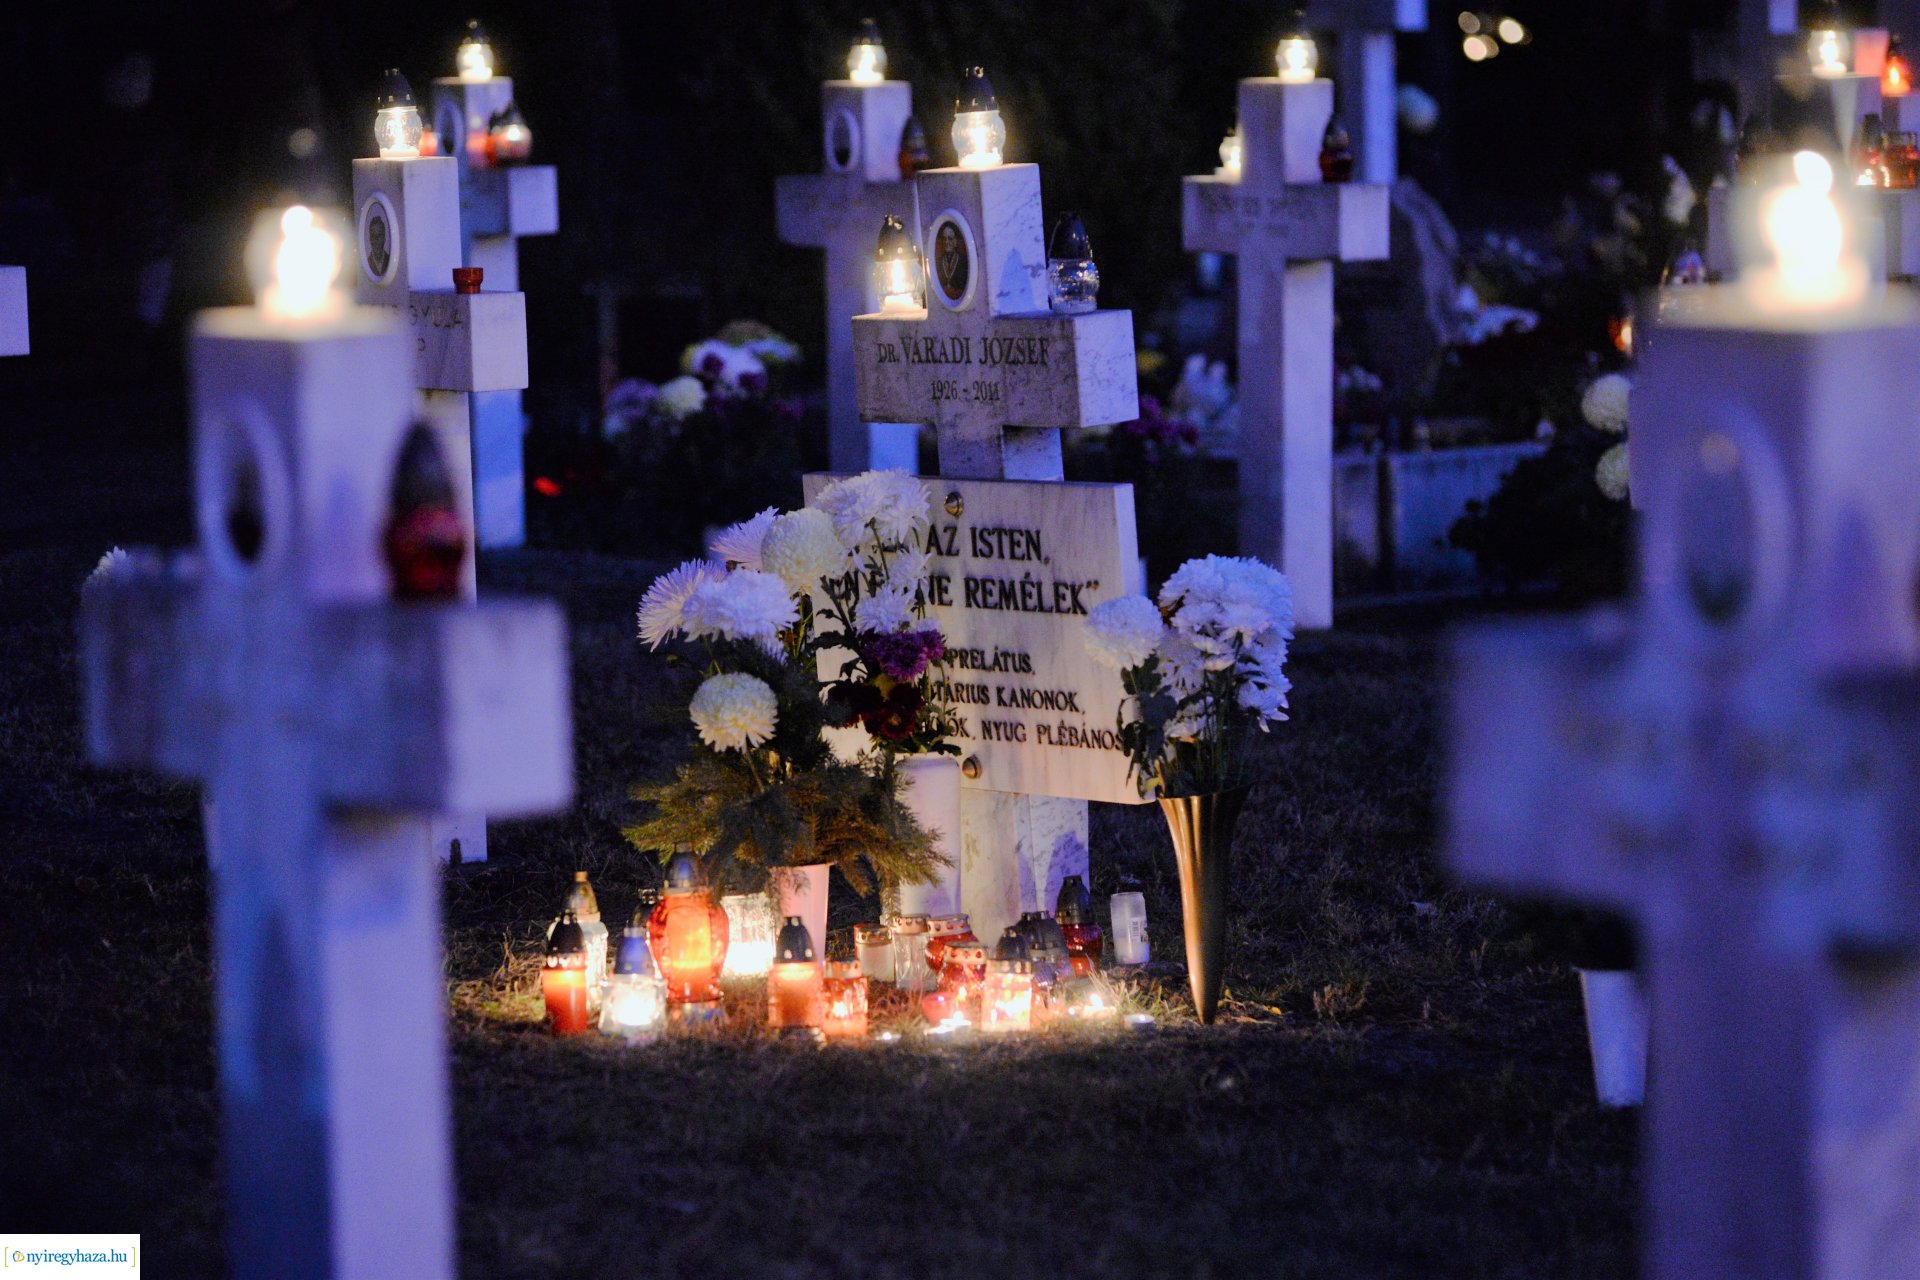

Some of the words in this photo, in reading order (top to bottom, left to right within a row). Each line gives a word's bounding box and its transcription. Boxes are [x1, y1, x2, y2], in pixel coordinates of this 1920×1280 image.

[877, 342, 900, 365] DR.
[900, 330, 973, 366] VÁRADI
[979, 332, 1050, 367] JÓZSEF
[925, 523, 960, 557] AZ
